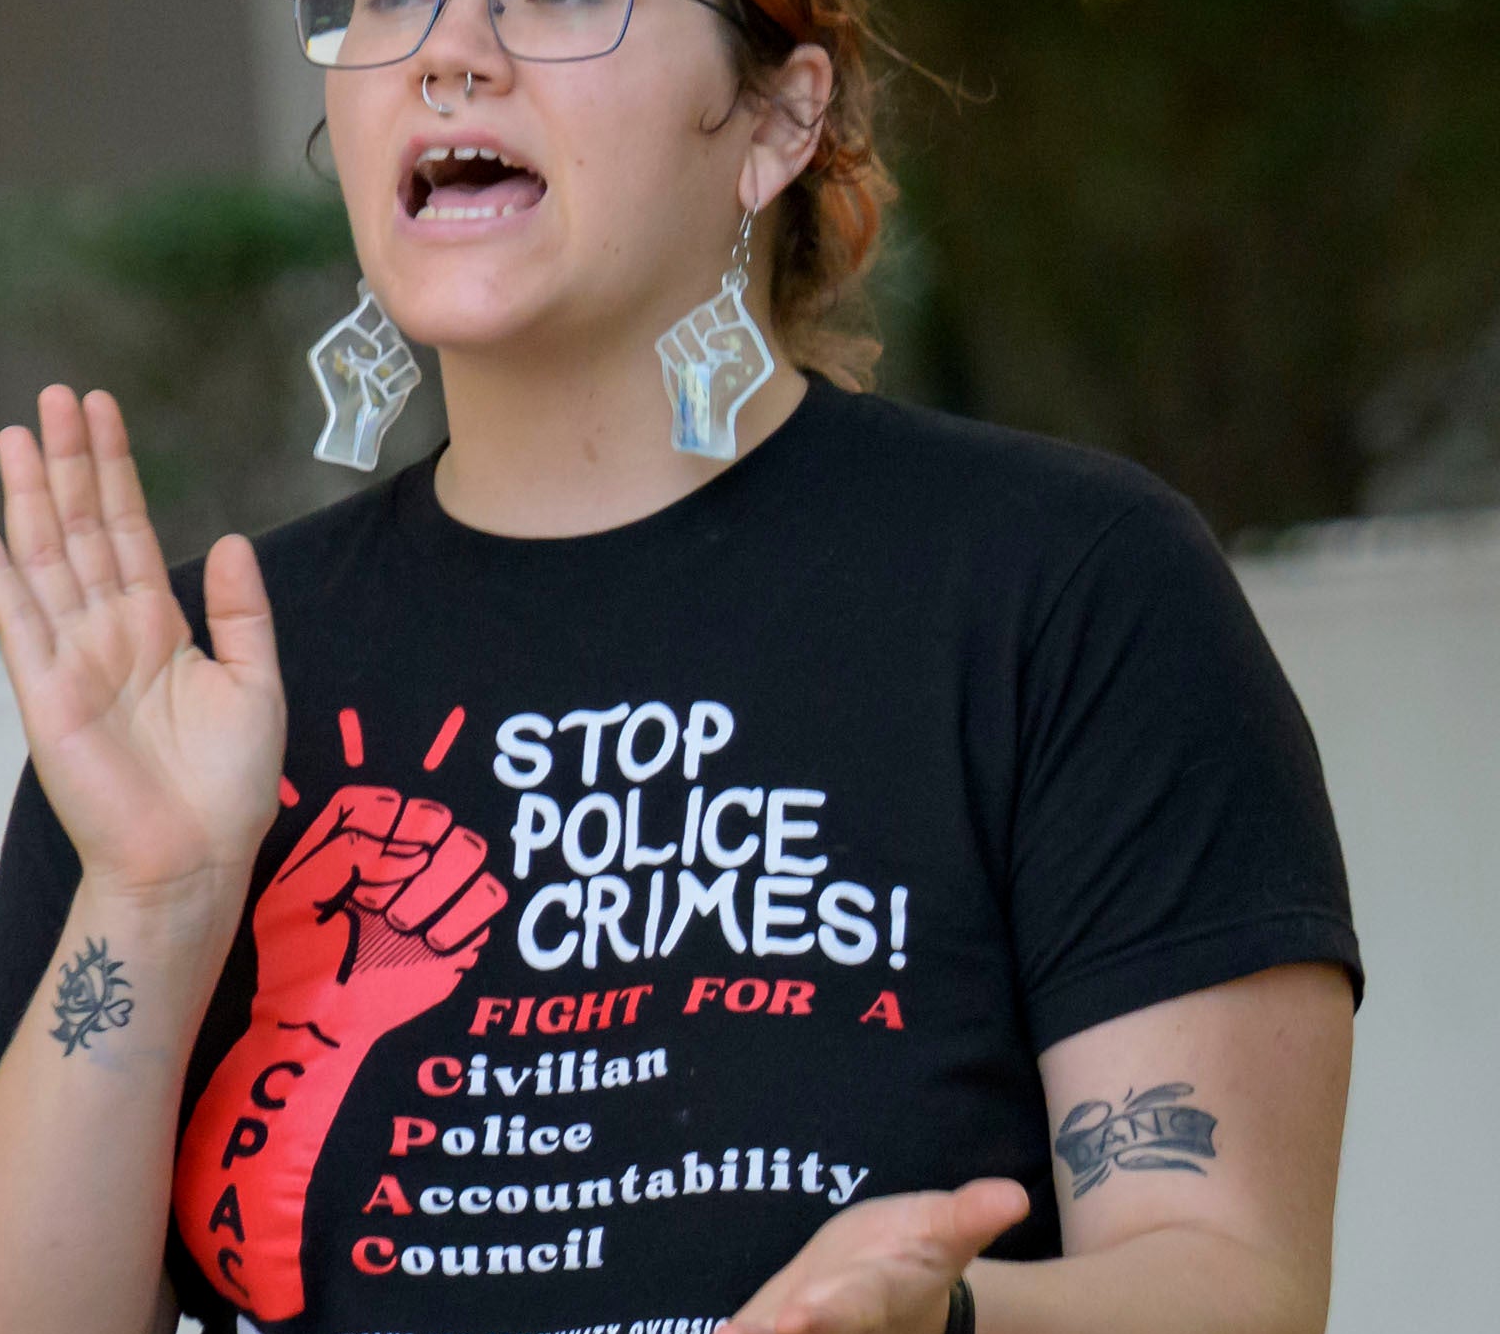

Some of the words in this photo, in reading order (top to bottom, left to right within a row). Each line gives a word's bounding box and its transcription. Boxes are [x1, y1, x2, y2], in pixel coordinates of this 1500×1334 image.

[492, 700, 735, 790] STOP
[511, 786, 830, 880] POLICE
[516, 870, 912, 973] CRIMES!
[468, 984, 655, 1040] FIGHT
[684, 976, 815, 1018] FOR
[860, 988, 906, 1030] A
[418, 1043, 668, 1099] Civilian
[390, 1114, 594, 1158] Police
[362, 1147, 871, 1218] Accountability
[351, 1227, 606, 1278] Council
